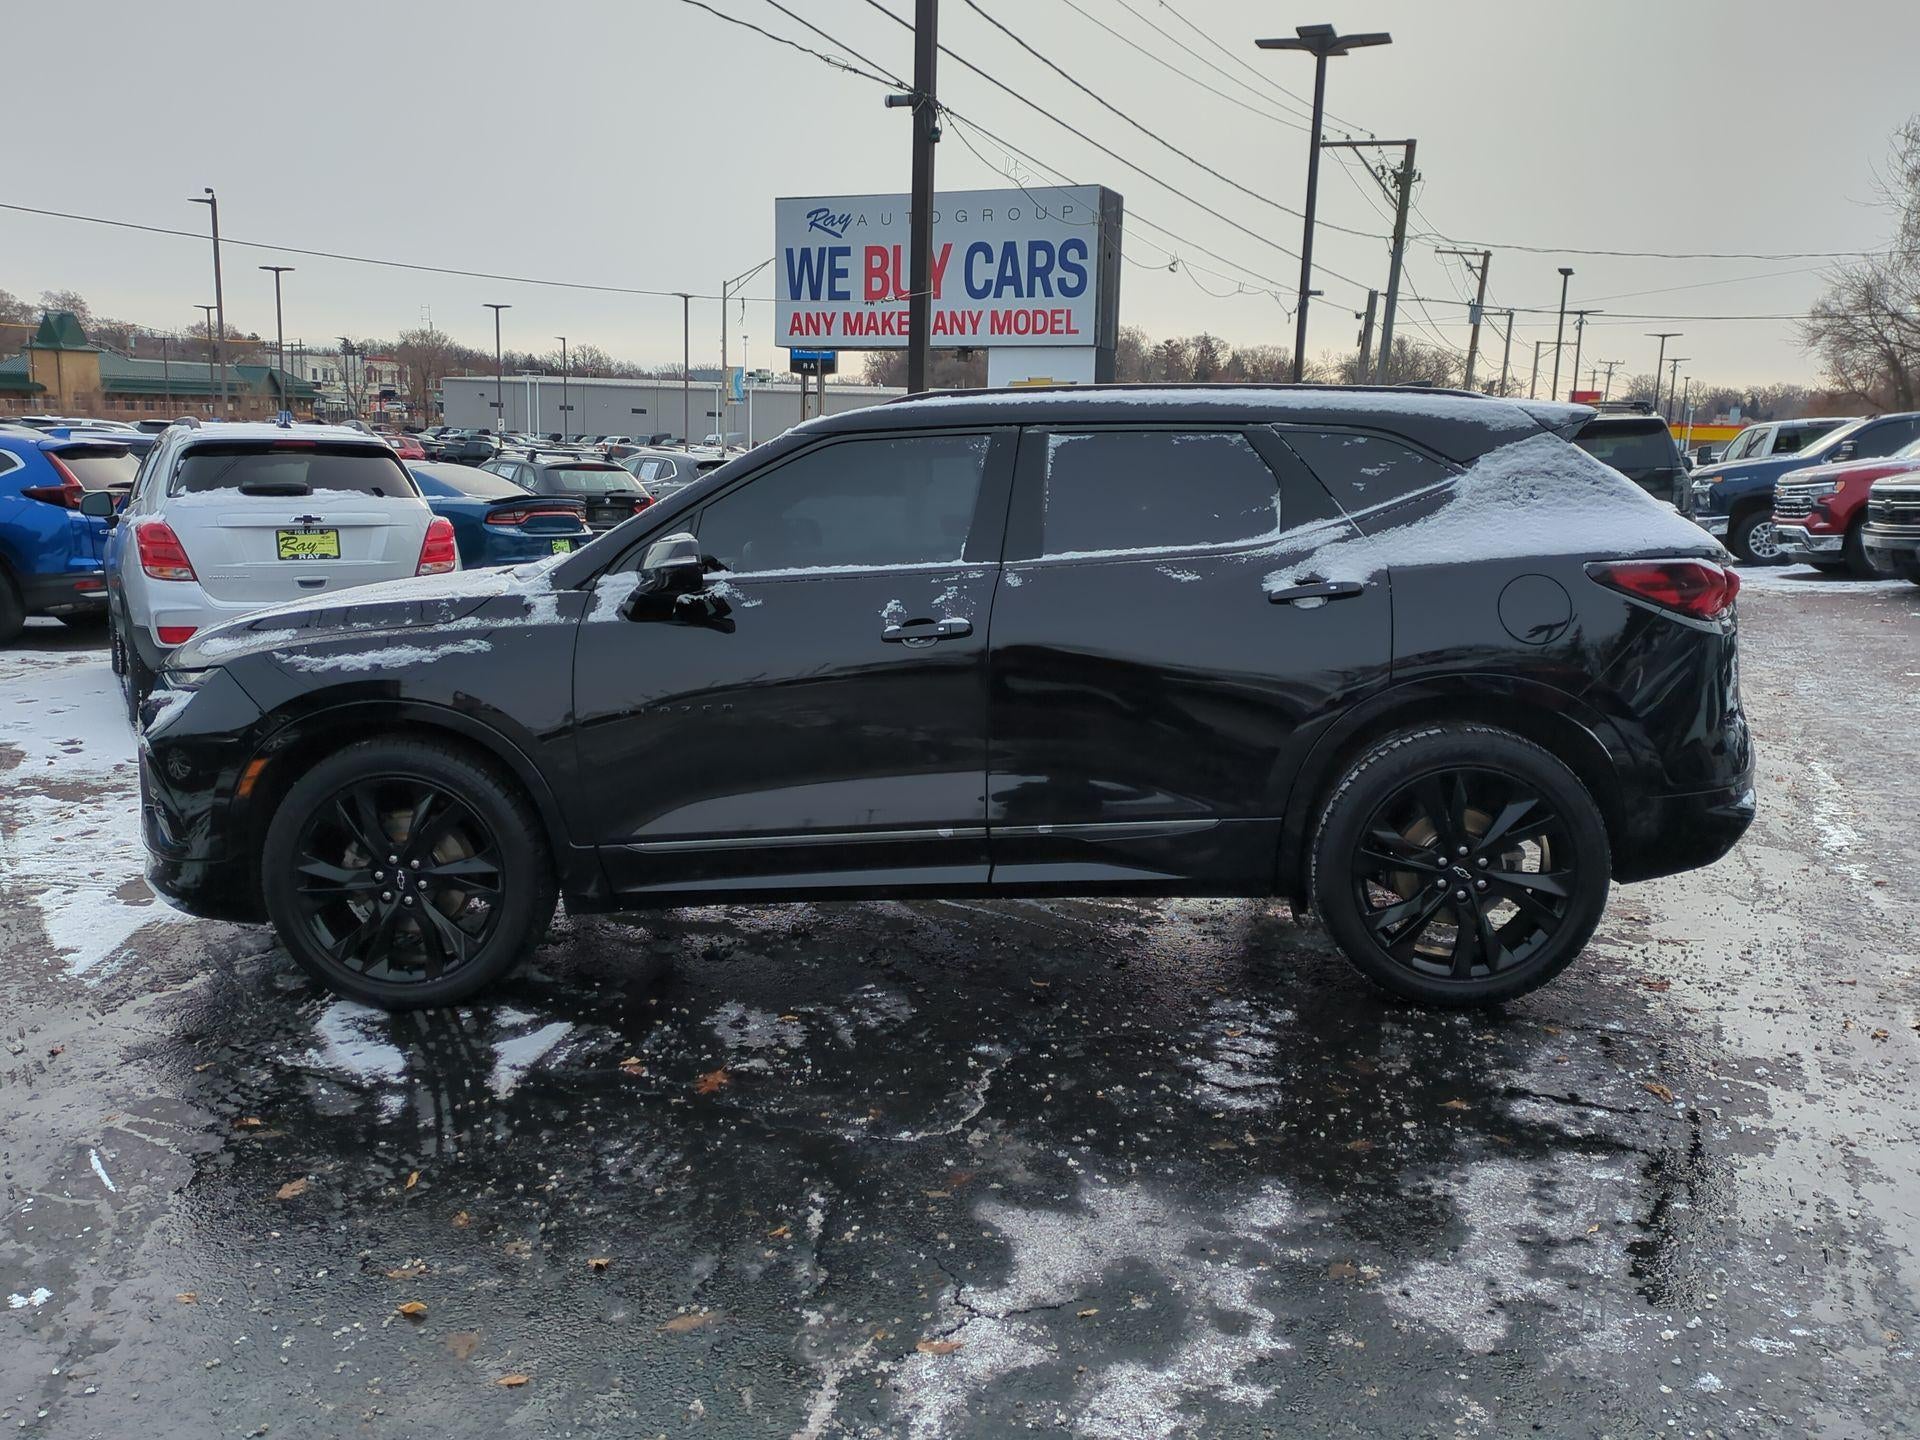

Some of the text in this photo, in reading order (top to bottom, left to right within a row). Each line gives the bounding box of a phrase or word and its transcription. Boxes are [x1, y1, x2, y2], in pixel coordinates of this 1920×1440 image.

[806, 208, 853, 239] Ray
[785, 238, 1088, 301] WE BUY CARS
[789, 309, 1079, 336] ANY MAKE ANY MODEL
[280, 536, 318, 554] Ray
